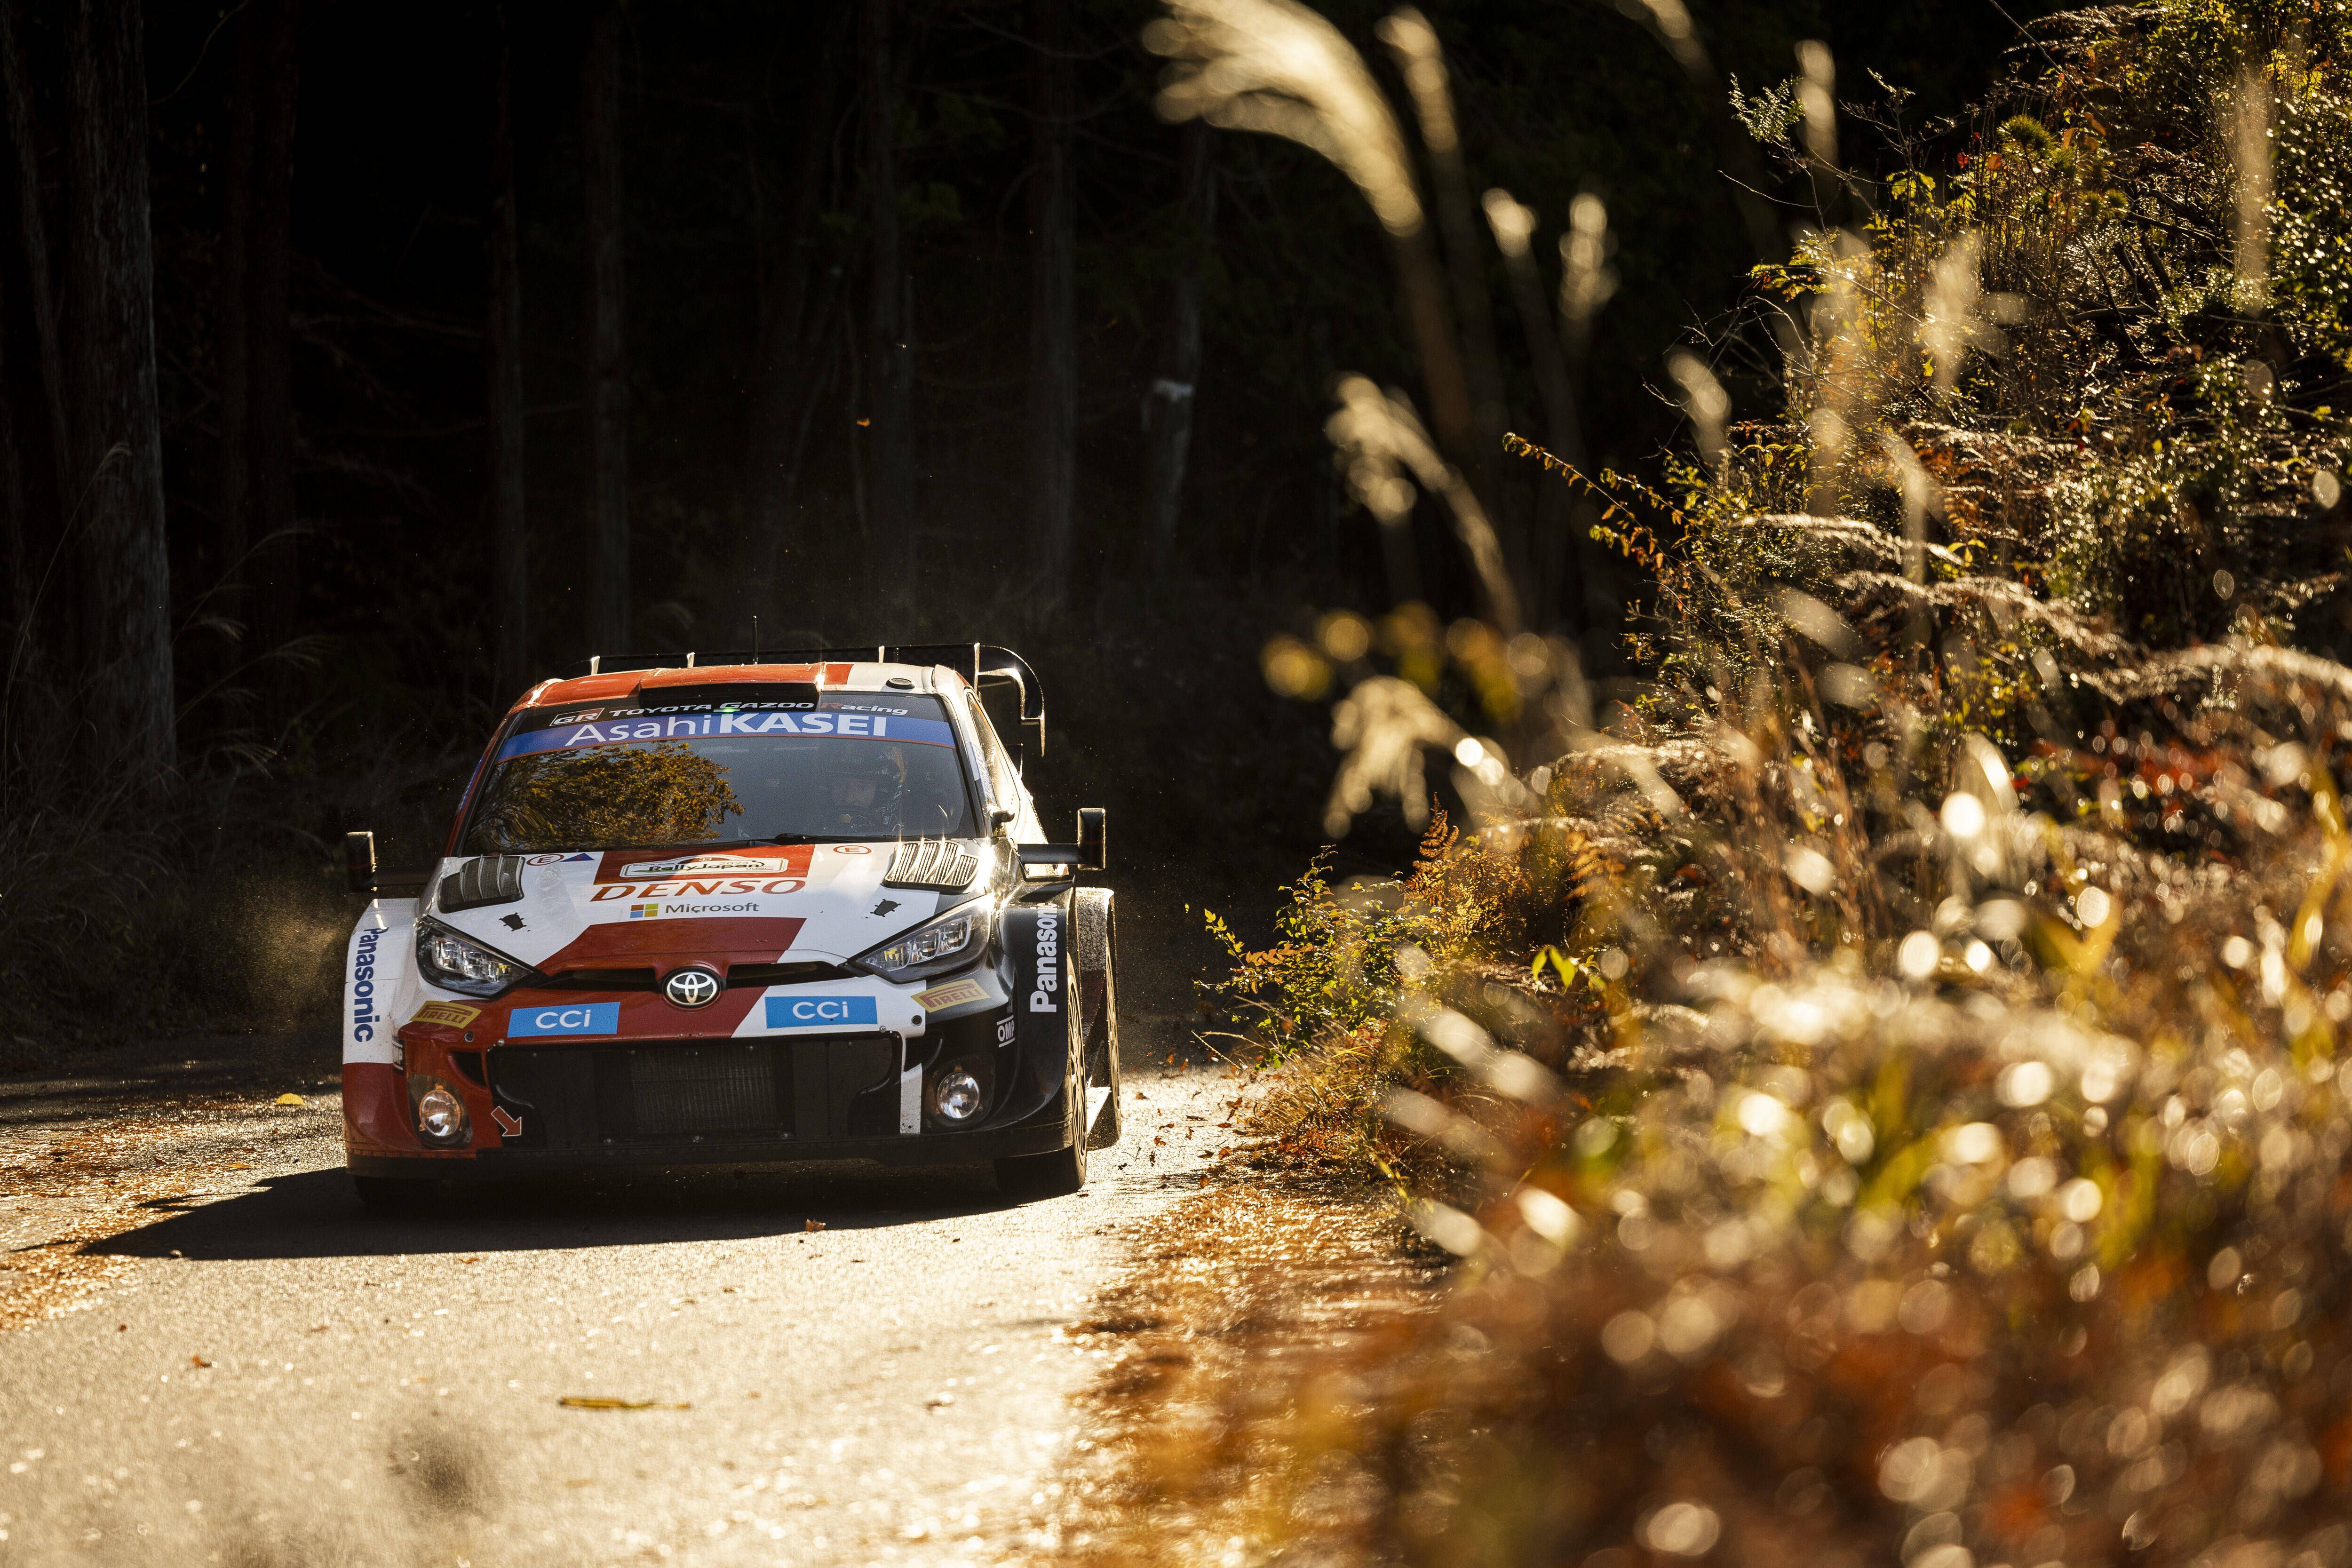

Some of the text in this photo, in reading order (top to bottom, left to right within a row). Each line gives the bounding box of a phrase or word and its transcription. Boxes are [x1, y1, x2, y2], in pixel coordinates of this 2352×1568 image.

[553, 712, 598, 725] GR
[609, 704, 711, 717] TOYOTA
[821, 702, 908, 716] Racing
[589, 880, 806, 902] DENSO
[665, 902, 760, 914] Microsoft
[1030, 902, 1058, 1012] Panasonic
[354, 927, 389, 1043] Panasonic
[919, 983, 983, 1008] PIRELLI
[416, 1004, 474, 1024] PIRELLI
[997, 1019, 1015, 1042] OMP
